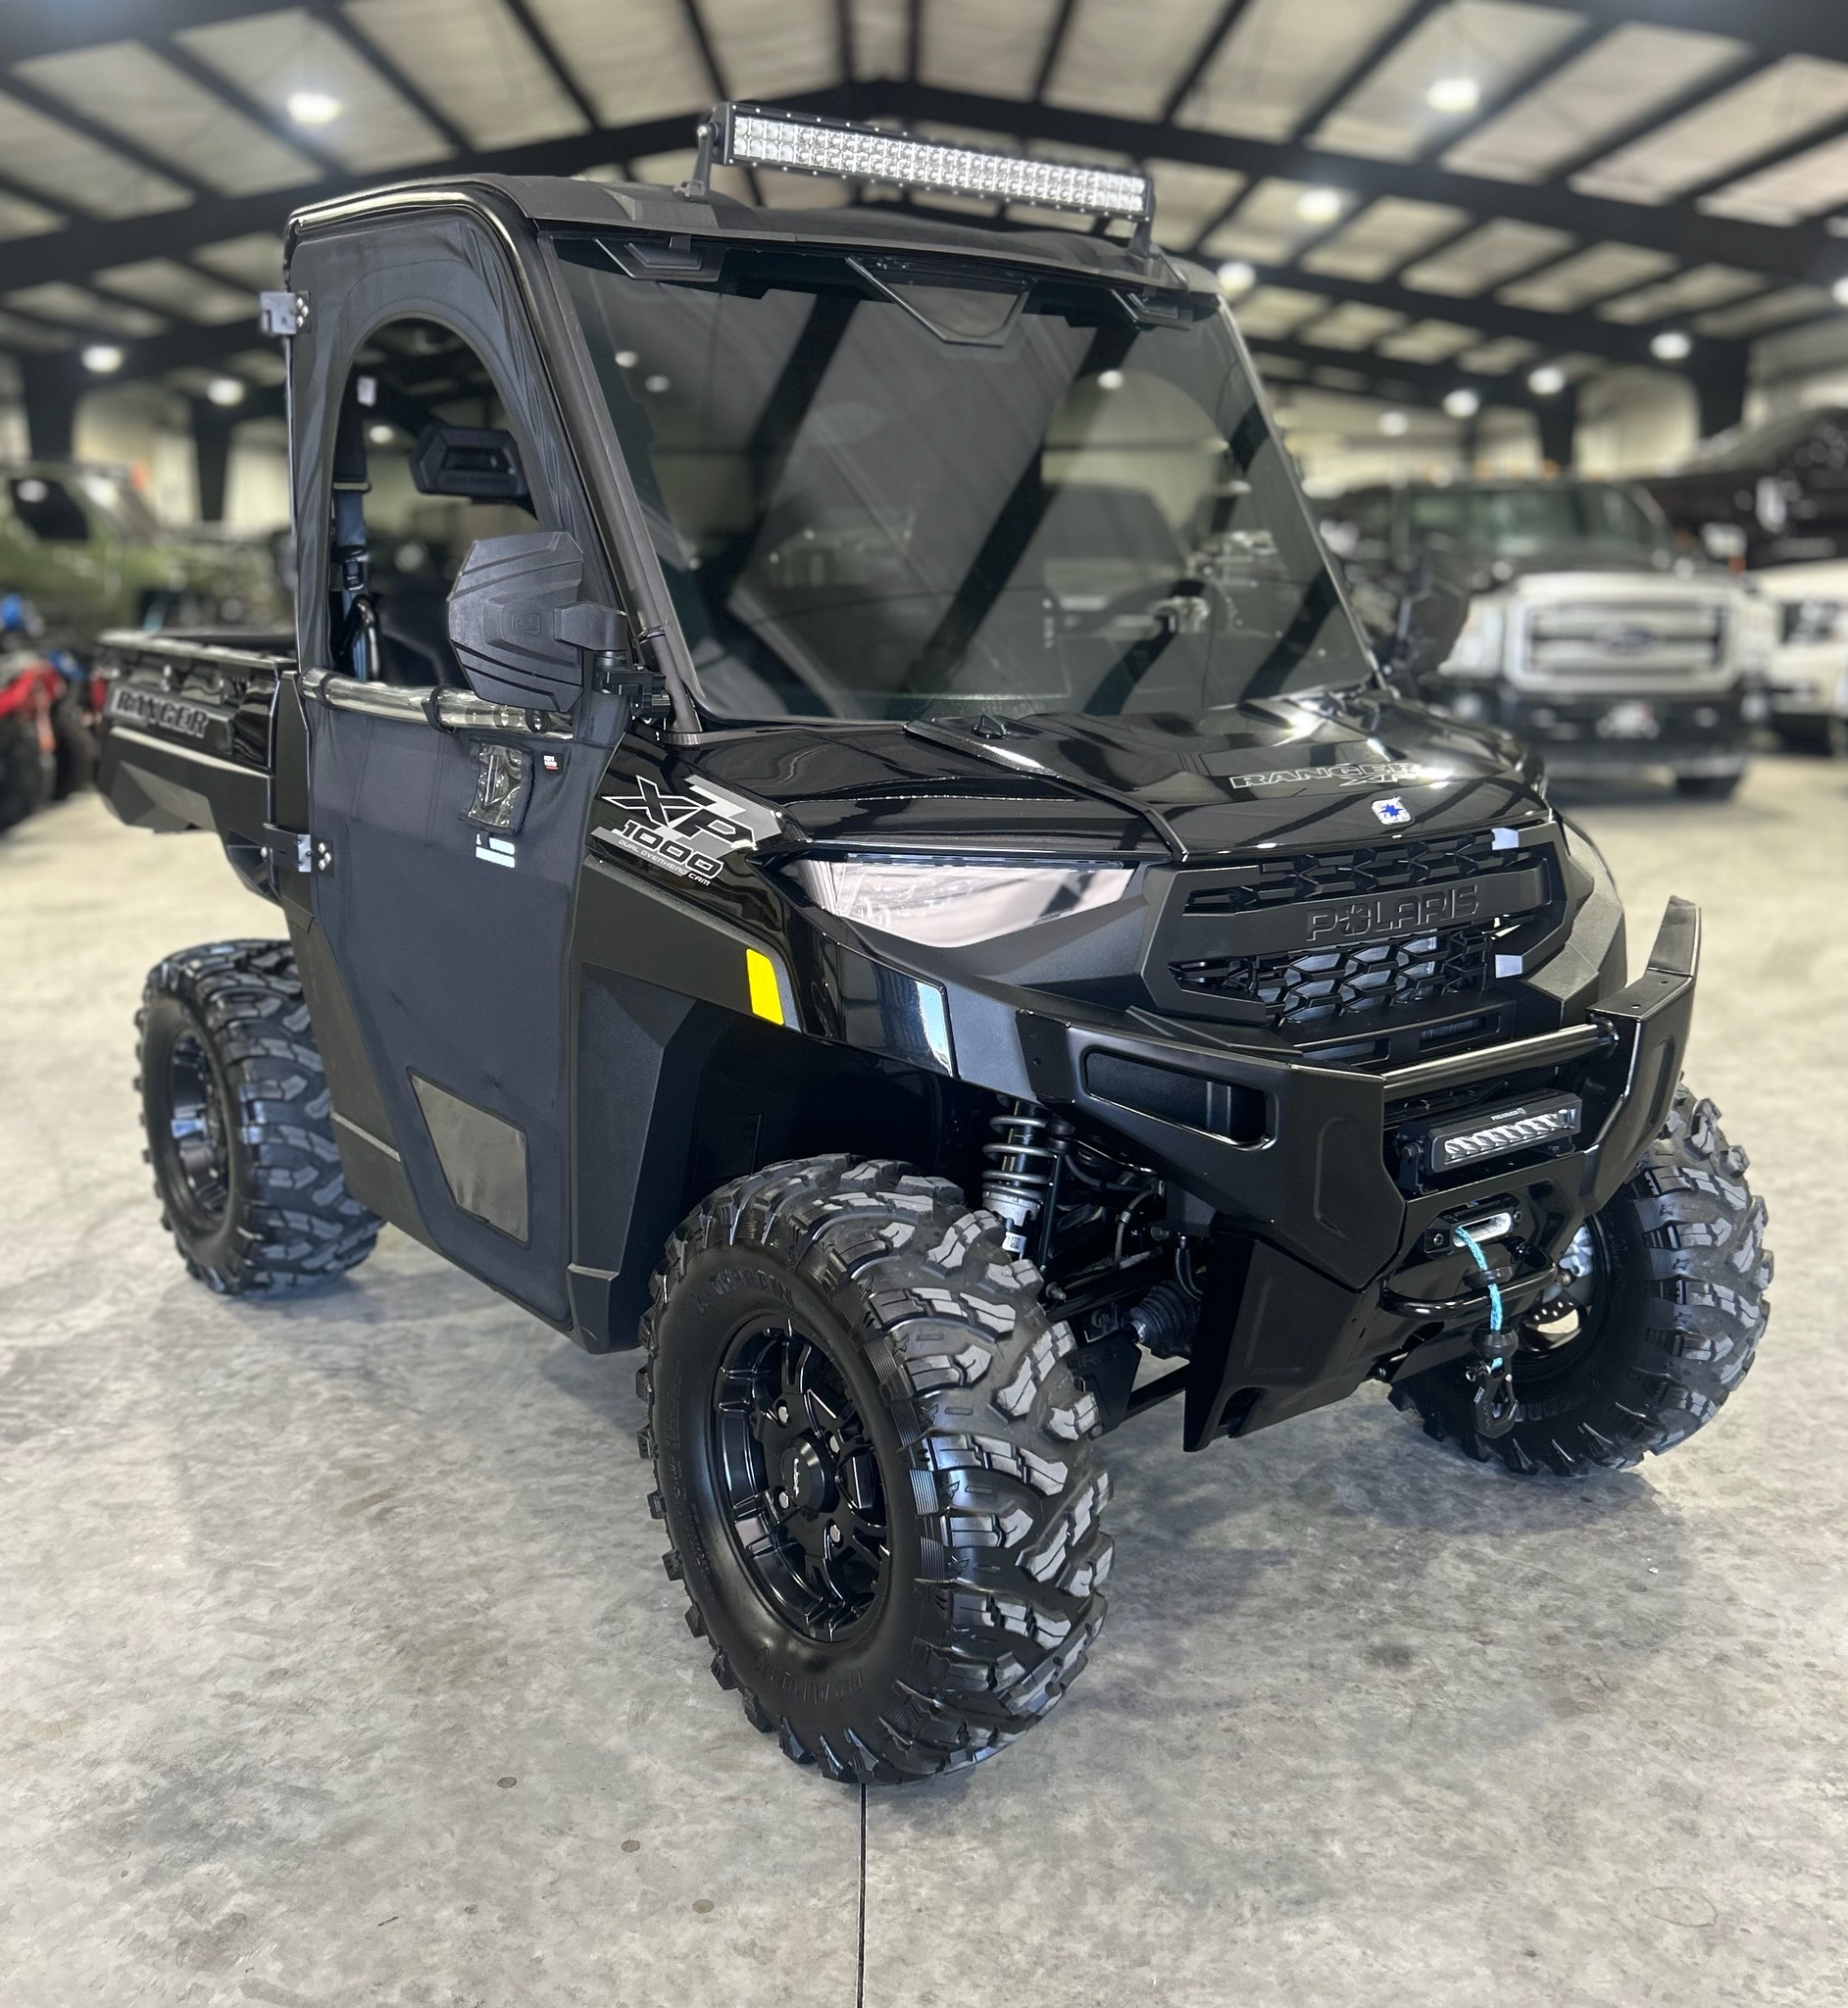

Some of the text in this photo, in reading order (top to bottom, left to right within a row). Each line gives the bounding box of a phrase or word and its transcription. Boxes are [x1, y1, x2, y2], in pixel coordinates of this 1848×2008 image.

[114, 689, 210, 738] RANGER
[1229, 763, 1421, 788] RANGER
[601, 775, 757, 850] XP
[618, 838, 711, 886] DUAL OVERHEAD CAM
[621, 820, 724, 879] 1000
[1306, 884, 1479, 941] POLARIS
